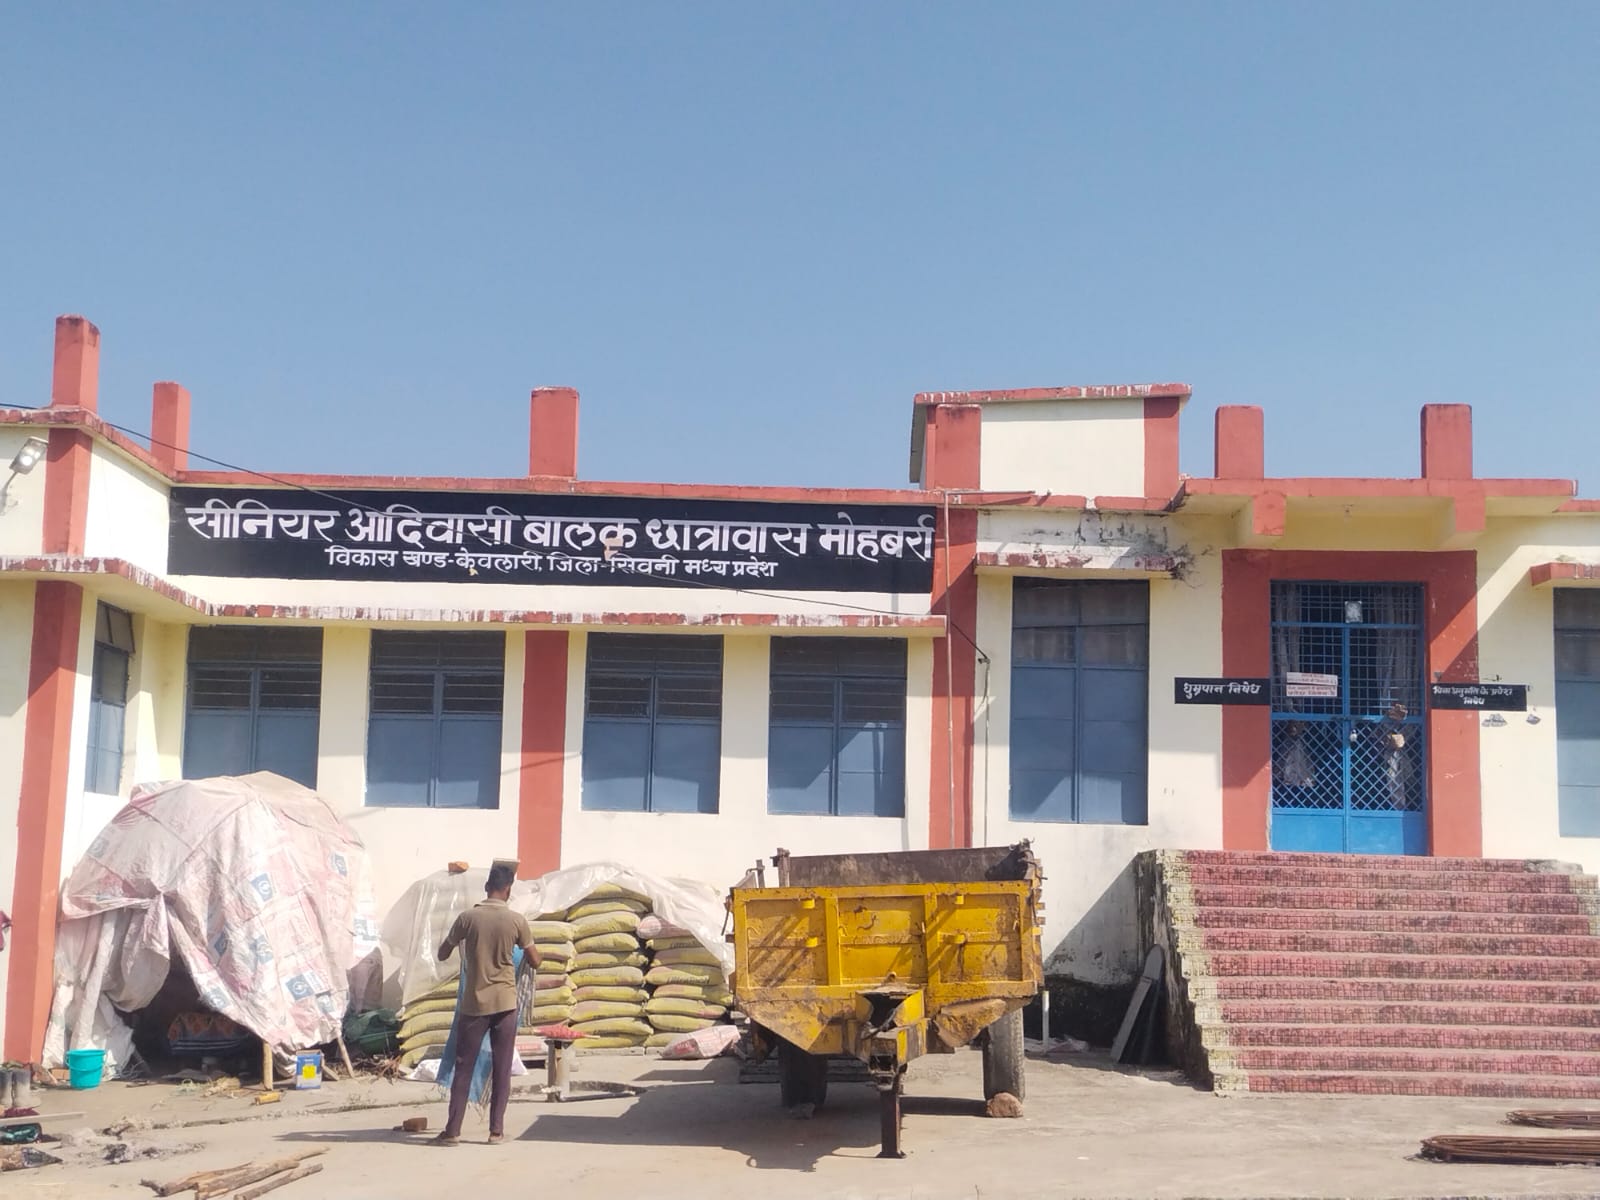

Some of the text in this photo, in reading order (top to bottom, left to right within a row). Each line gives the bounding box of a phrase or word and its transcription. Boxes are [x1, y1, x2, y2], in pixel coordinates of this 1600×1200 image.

[185, 498, 341, 542] सीनियर
[345, 503, 522, 548] आदिवासी
[522, 514, 640, 552] बालक
[645, 518, 814, 555] छात्रावास
[324, 544, 398, 566] विकास
[684, 558, 731, 577] मध्य
[732, 555, 779, 578] प्रदेश
